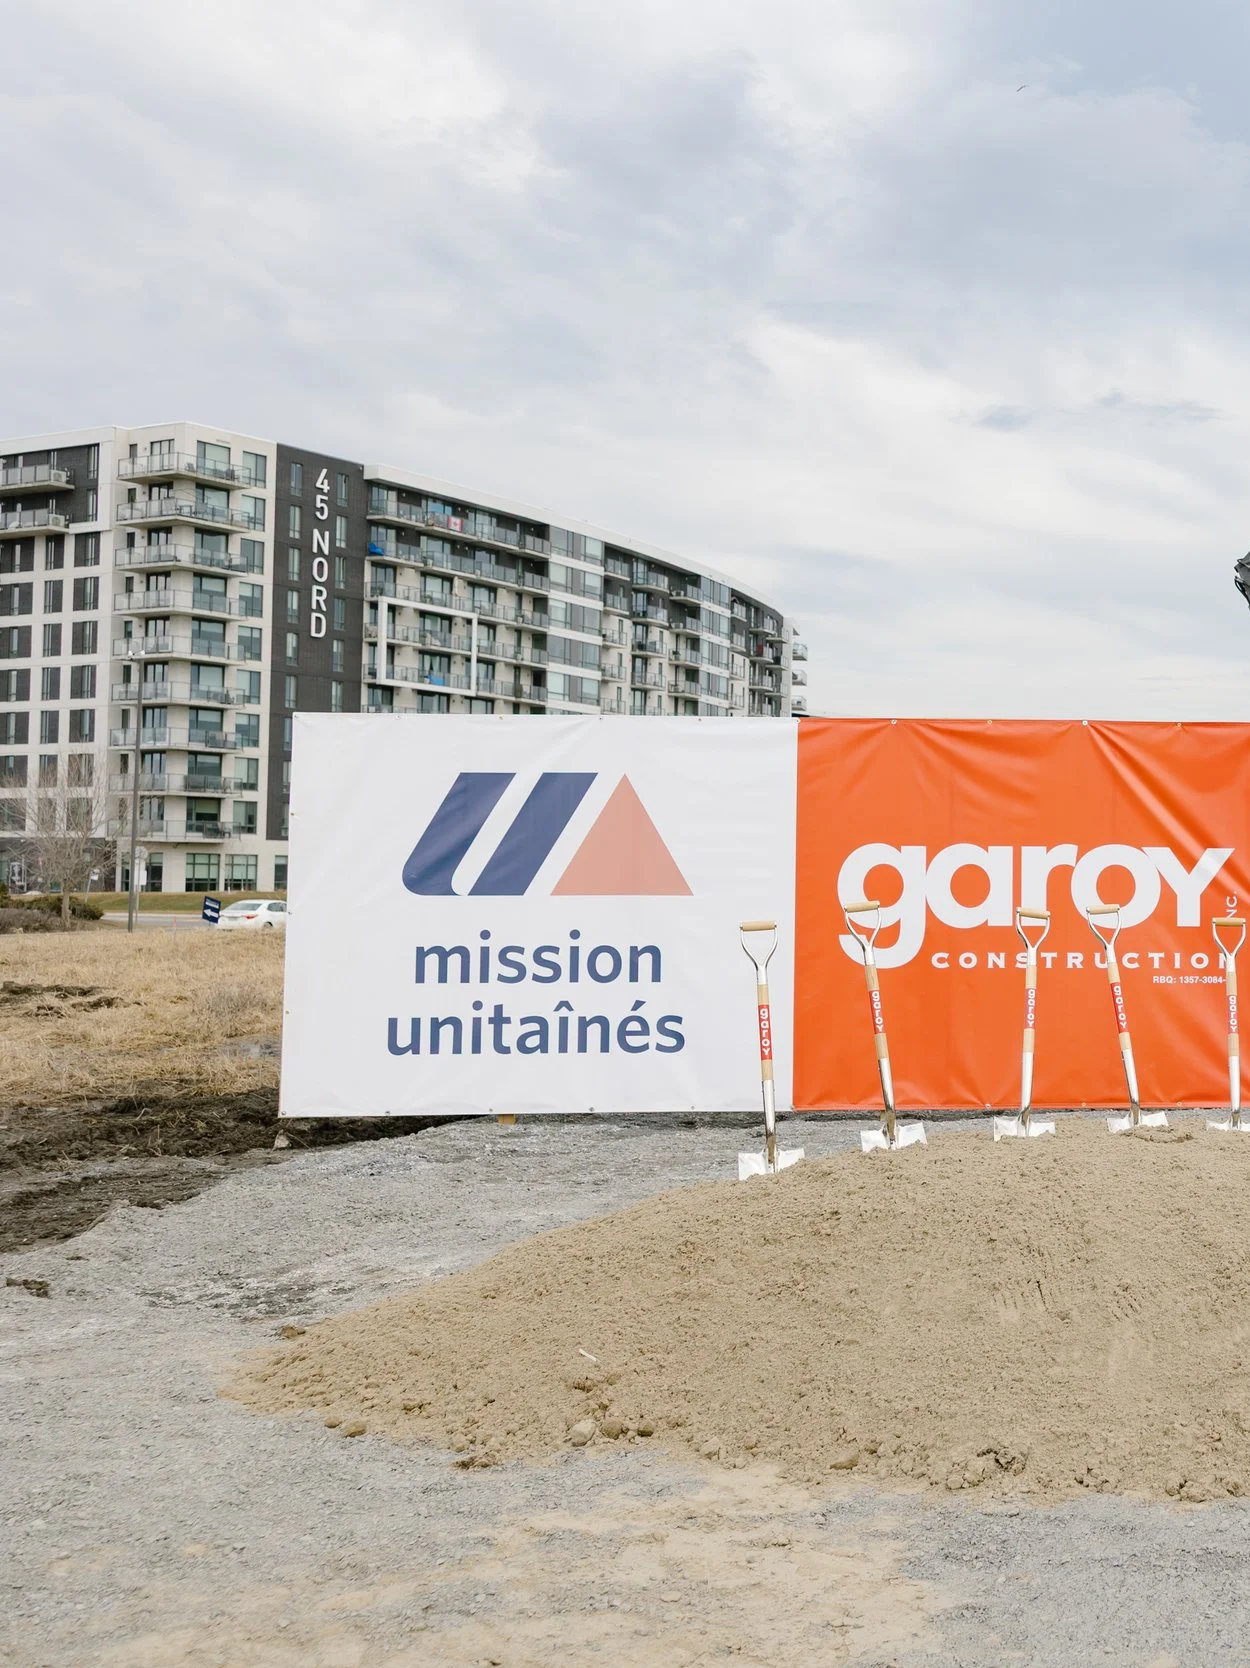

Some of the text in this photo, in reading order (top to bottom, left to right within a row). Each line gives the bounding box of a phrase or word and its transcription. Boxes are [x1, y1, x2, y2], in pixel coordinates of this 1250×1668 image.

[310, 468, 330, 638] 45 NORD
[837, 842, 1234, 969] garoy
[1226, 890, 1238, 919] NC.
[414, 929, 661, 984] mission
[1152, 976, 1227, 984] RBQ: 1357-3084-
[387, 1000, 685, 1056] unitaînés
